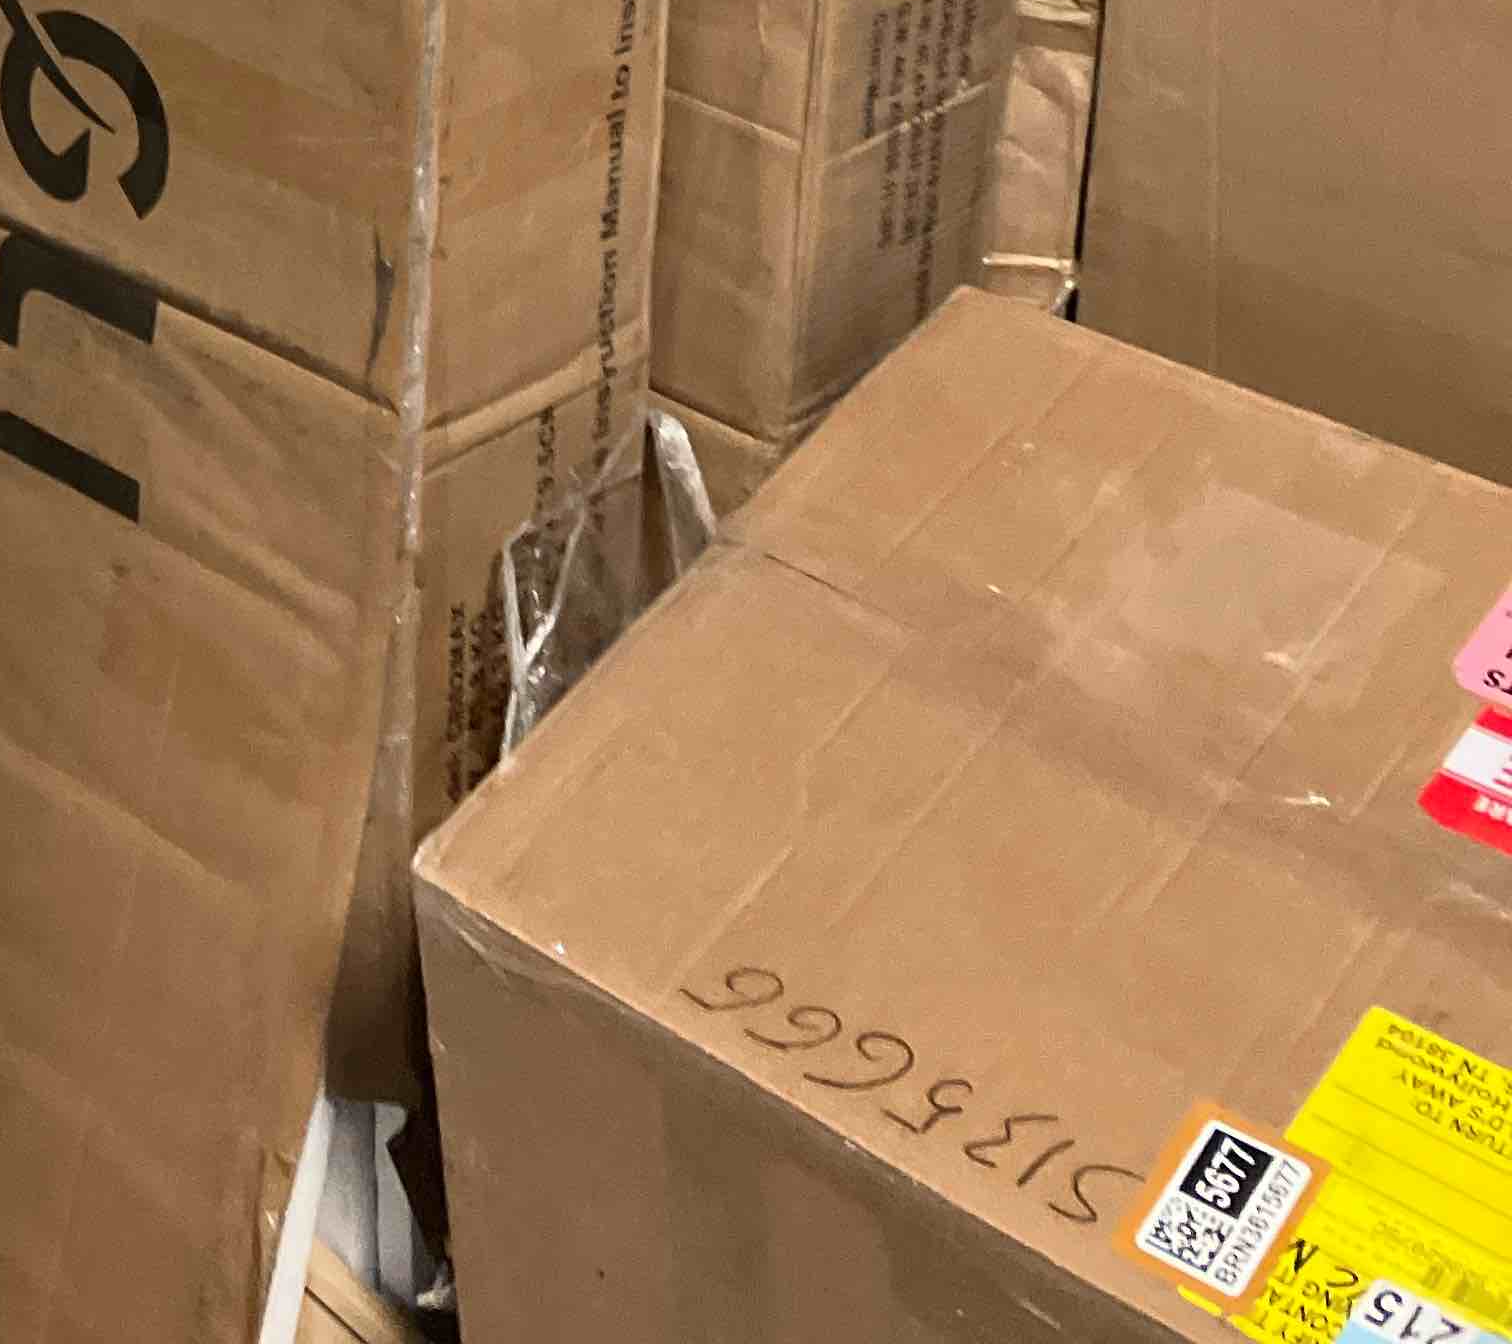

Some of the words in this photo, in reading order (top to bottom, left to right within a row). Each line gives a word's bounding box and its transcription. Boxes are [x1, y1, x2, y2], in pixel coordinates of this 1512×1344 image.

[610, 64, 631, 102] to
[600, 110, 626, 240] Manual
[1194, 1137, 1256, 1209] 5677
